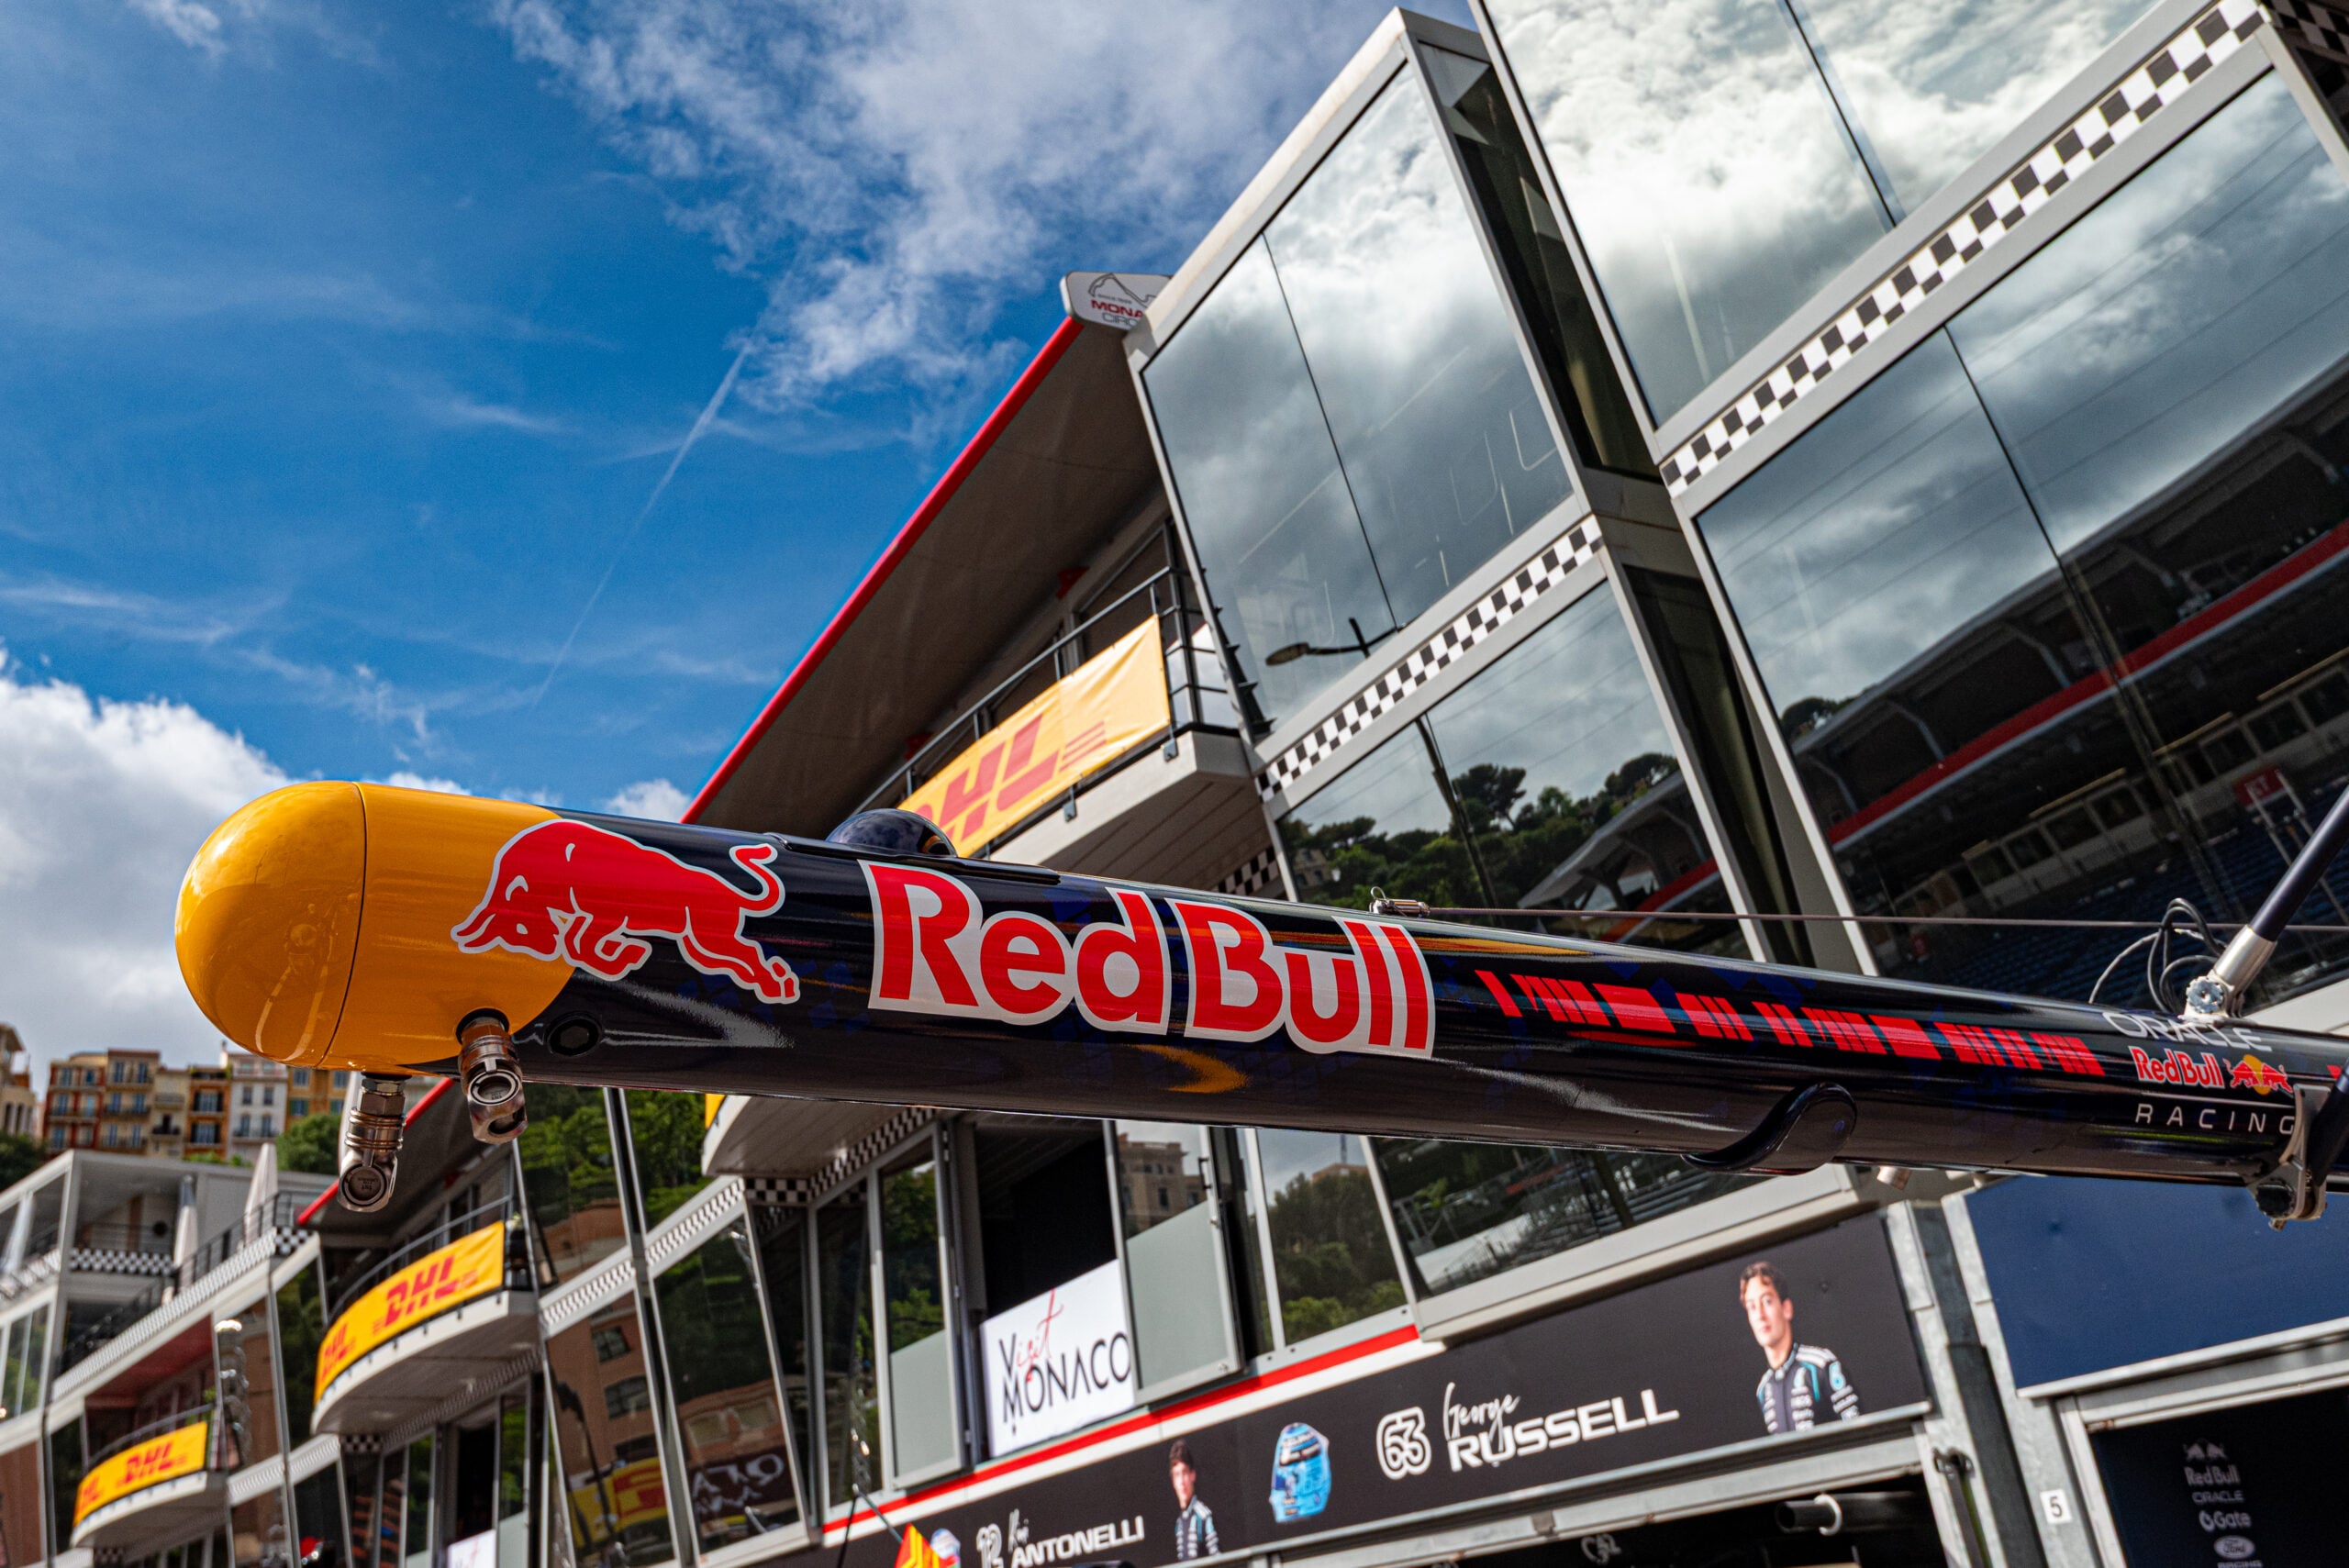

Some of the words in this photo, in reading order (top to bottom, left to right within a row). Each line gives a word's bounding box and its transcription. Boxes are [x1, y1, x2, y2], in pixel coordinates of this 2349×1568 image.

[916, 713, 1060, 841] HL
[2102, 1011, 2272, 1051] ORACLE
[2135, 1103, 2295, 1135] RACING
[384, 1254, 459, 1328] DHL
[1003, 1332, 1130, 1436] MONACO
[1376, 1407, 1431, 1475] 63
[1447, 1388, 1680, 1472] RUSSELL
[2049, 1496, 2063, 1518] 5
[2191, 1490, 2244, 1504] ORACLE
[1010, 1515, 1145, 1568] ANTONELLI
